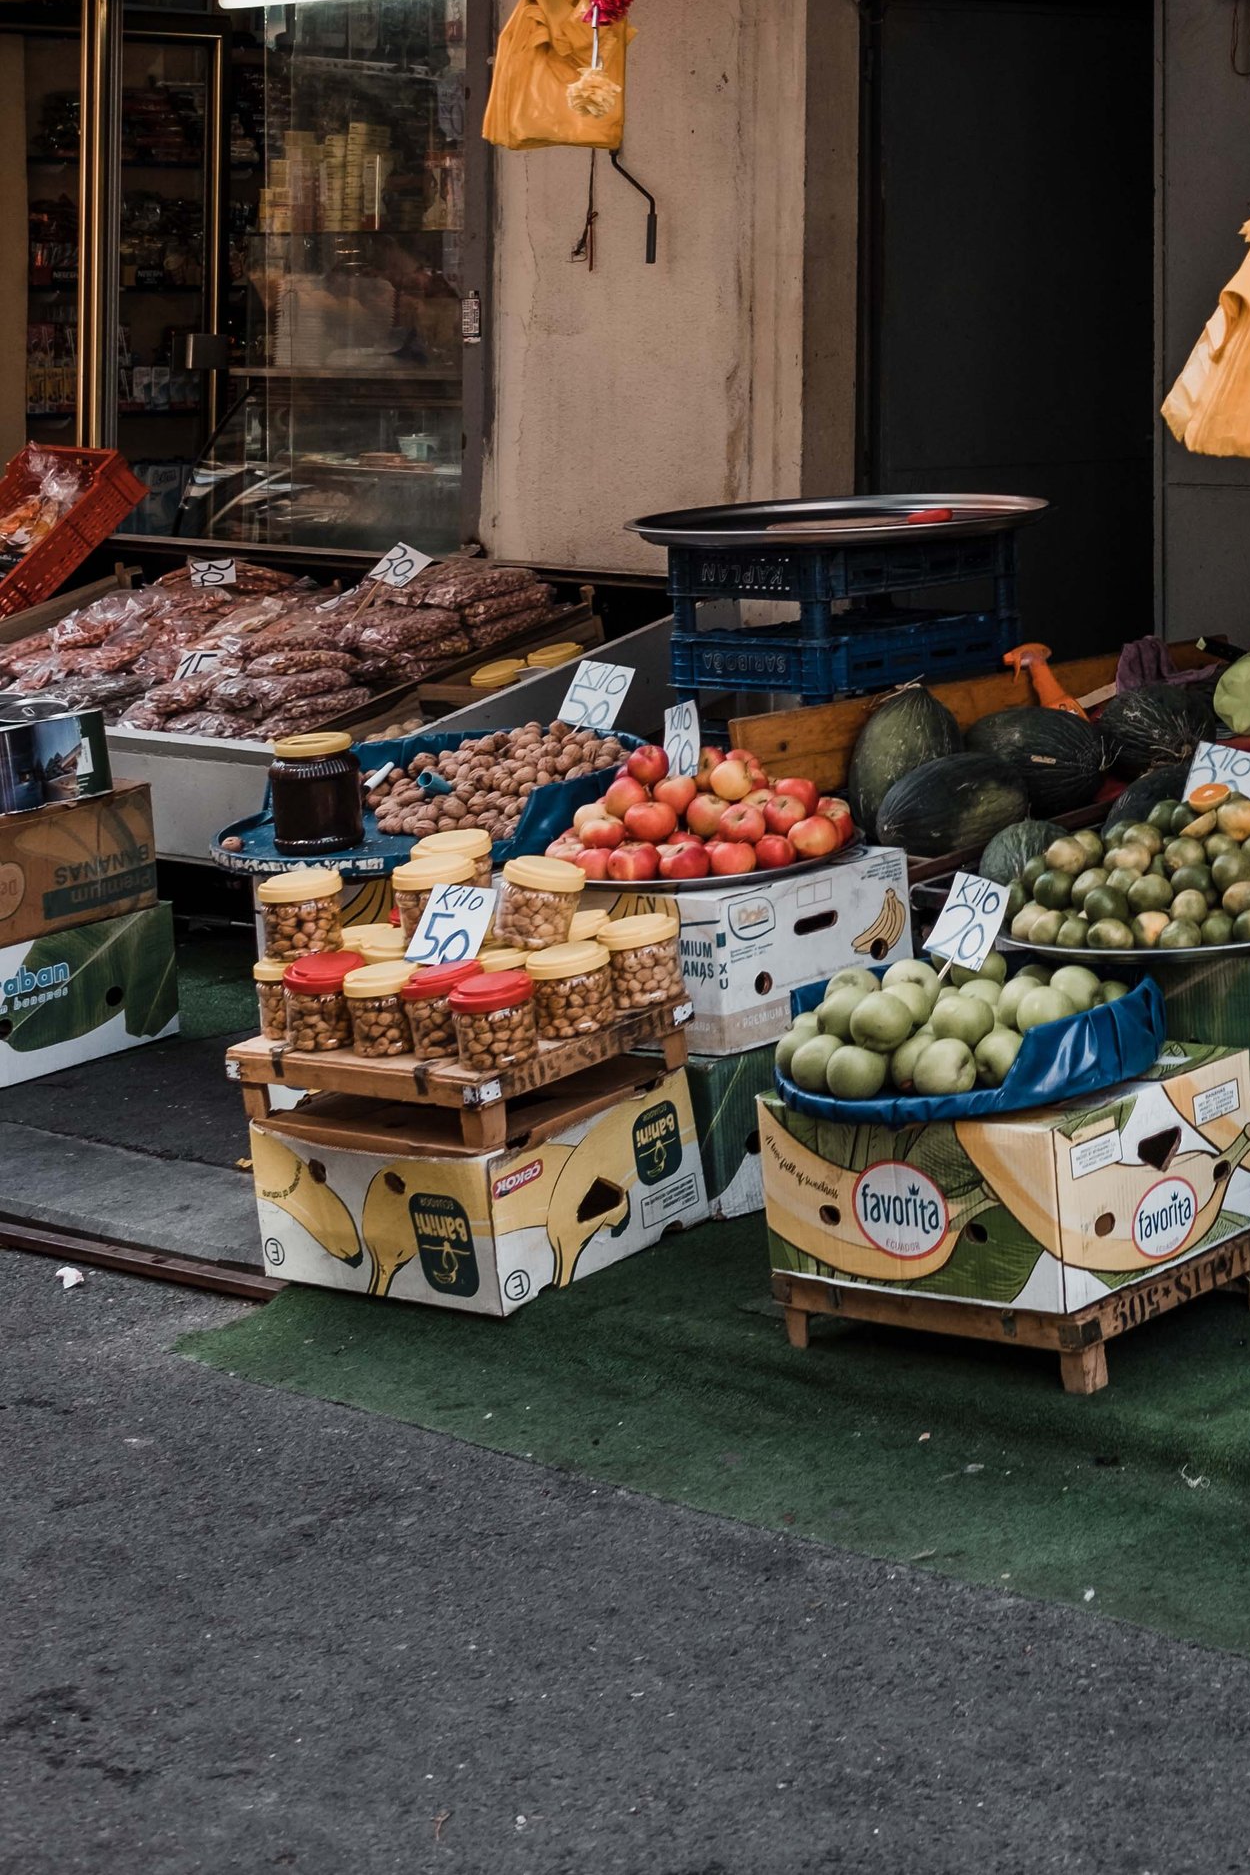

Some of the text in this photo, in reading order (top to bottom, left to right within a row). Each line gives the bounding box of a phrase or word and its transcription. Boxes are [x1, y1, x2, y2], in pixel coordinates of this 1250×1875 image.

[370, 544, 415, 577] 30
[701, 563, 784, 585] KAPLAN
[577, 663, 628, 696] Kilo
[559, 684, 610, 727] 50
[669, 707, 693, 731] Kilo
[1189, 766, 1241, 793] 2
[54, 842, 149, 885] BANANAS
[69, 873, 151, 905] Premium
[435, 884, 485, 911] Kilo
[955, 877, 1000, 915] Kilo
[404, 912, 471, 966] 50
[922, 903, 985, 961] 20
[679, 939, 712, 959] MIUM
[0, 962, 70, 998] aban
[681, 961, 714, 980] ANAS
[635, 1113, 675, 1149] Banini
[861, 1182, 941, 1235] favorita
[1138, 1194, 1193, 1242] favorita
[414, 1211, 469, 1243] Banini
[886, 1238, 921, 1252] ECUADOR
